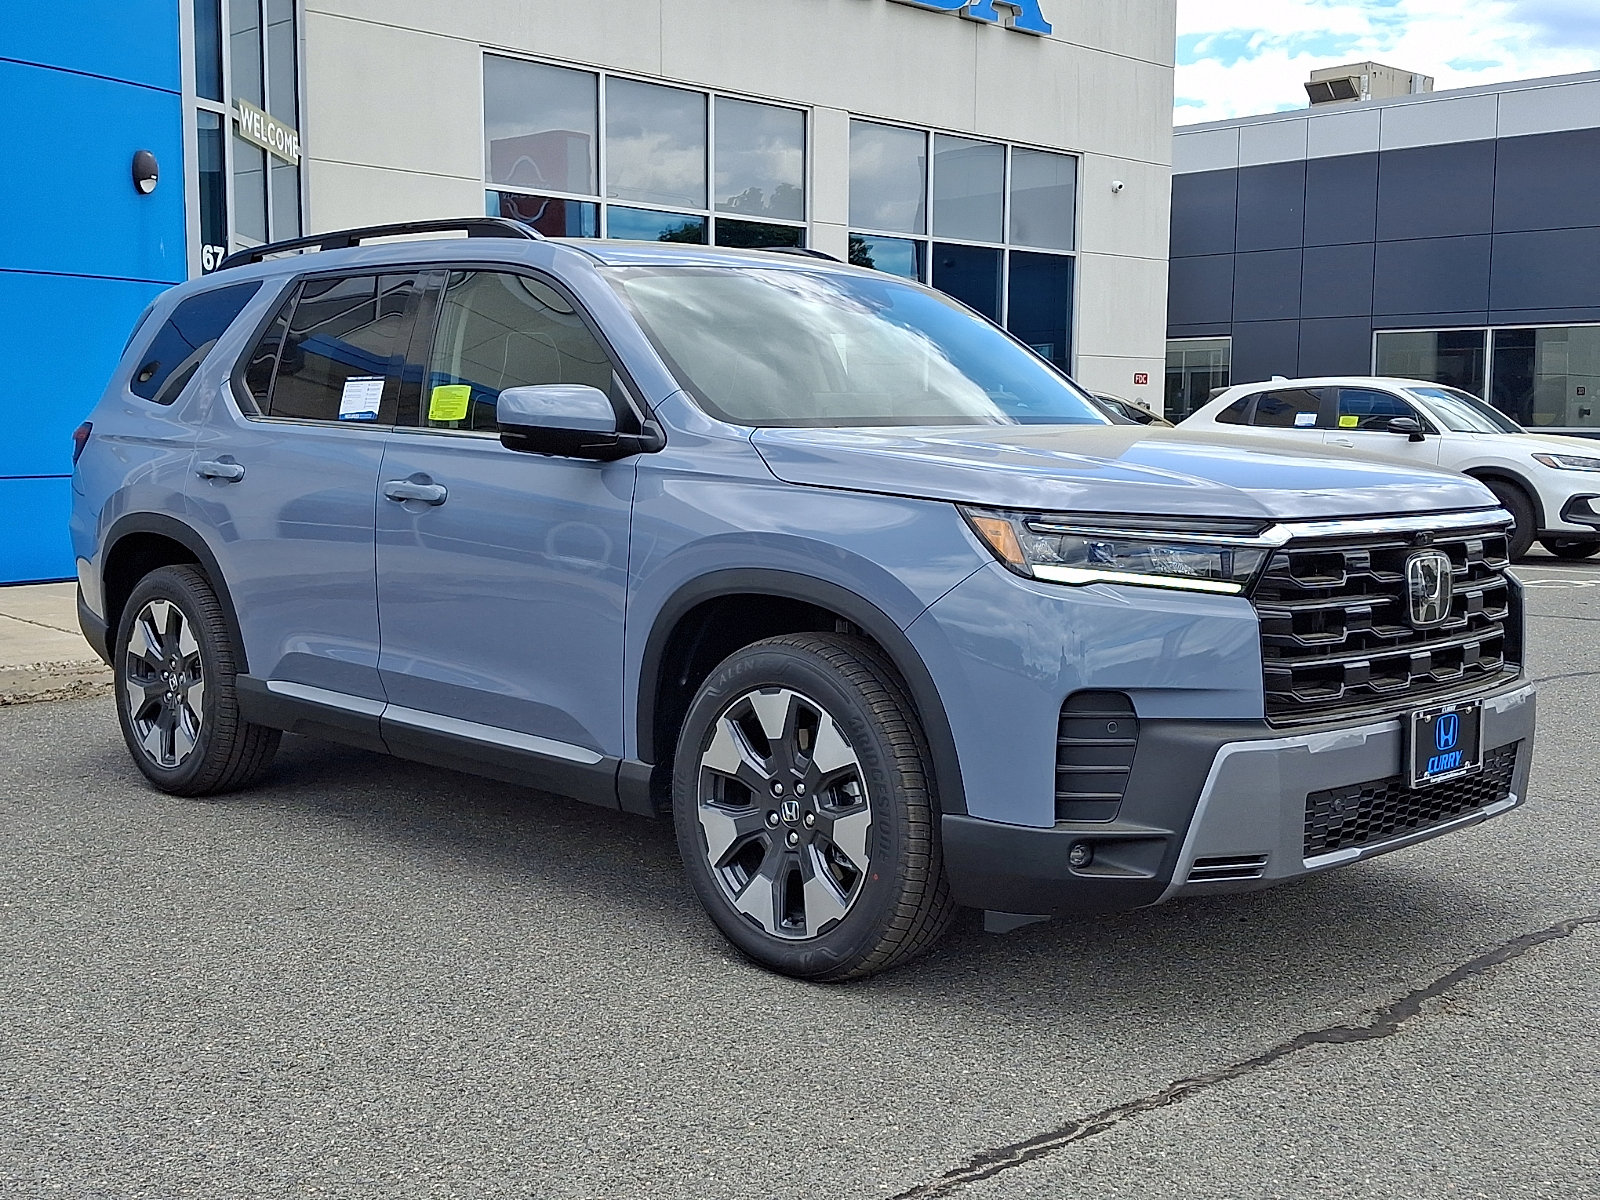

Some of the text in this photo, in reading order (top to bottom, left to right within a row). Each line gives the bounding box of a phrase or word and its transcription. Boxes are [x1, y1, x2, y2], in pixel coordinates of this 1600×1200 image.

[239, 103, 299, 160] WELCOME
[1135, 374, 1147, 384] FDC
[1427, 749, 1464, 774] CURRY
